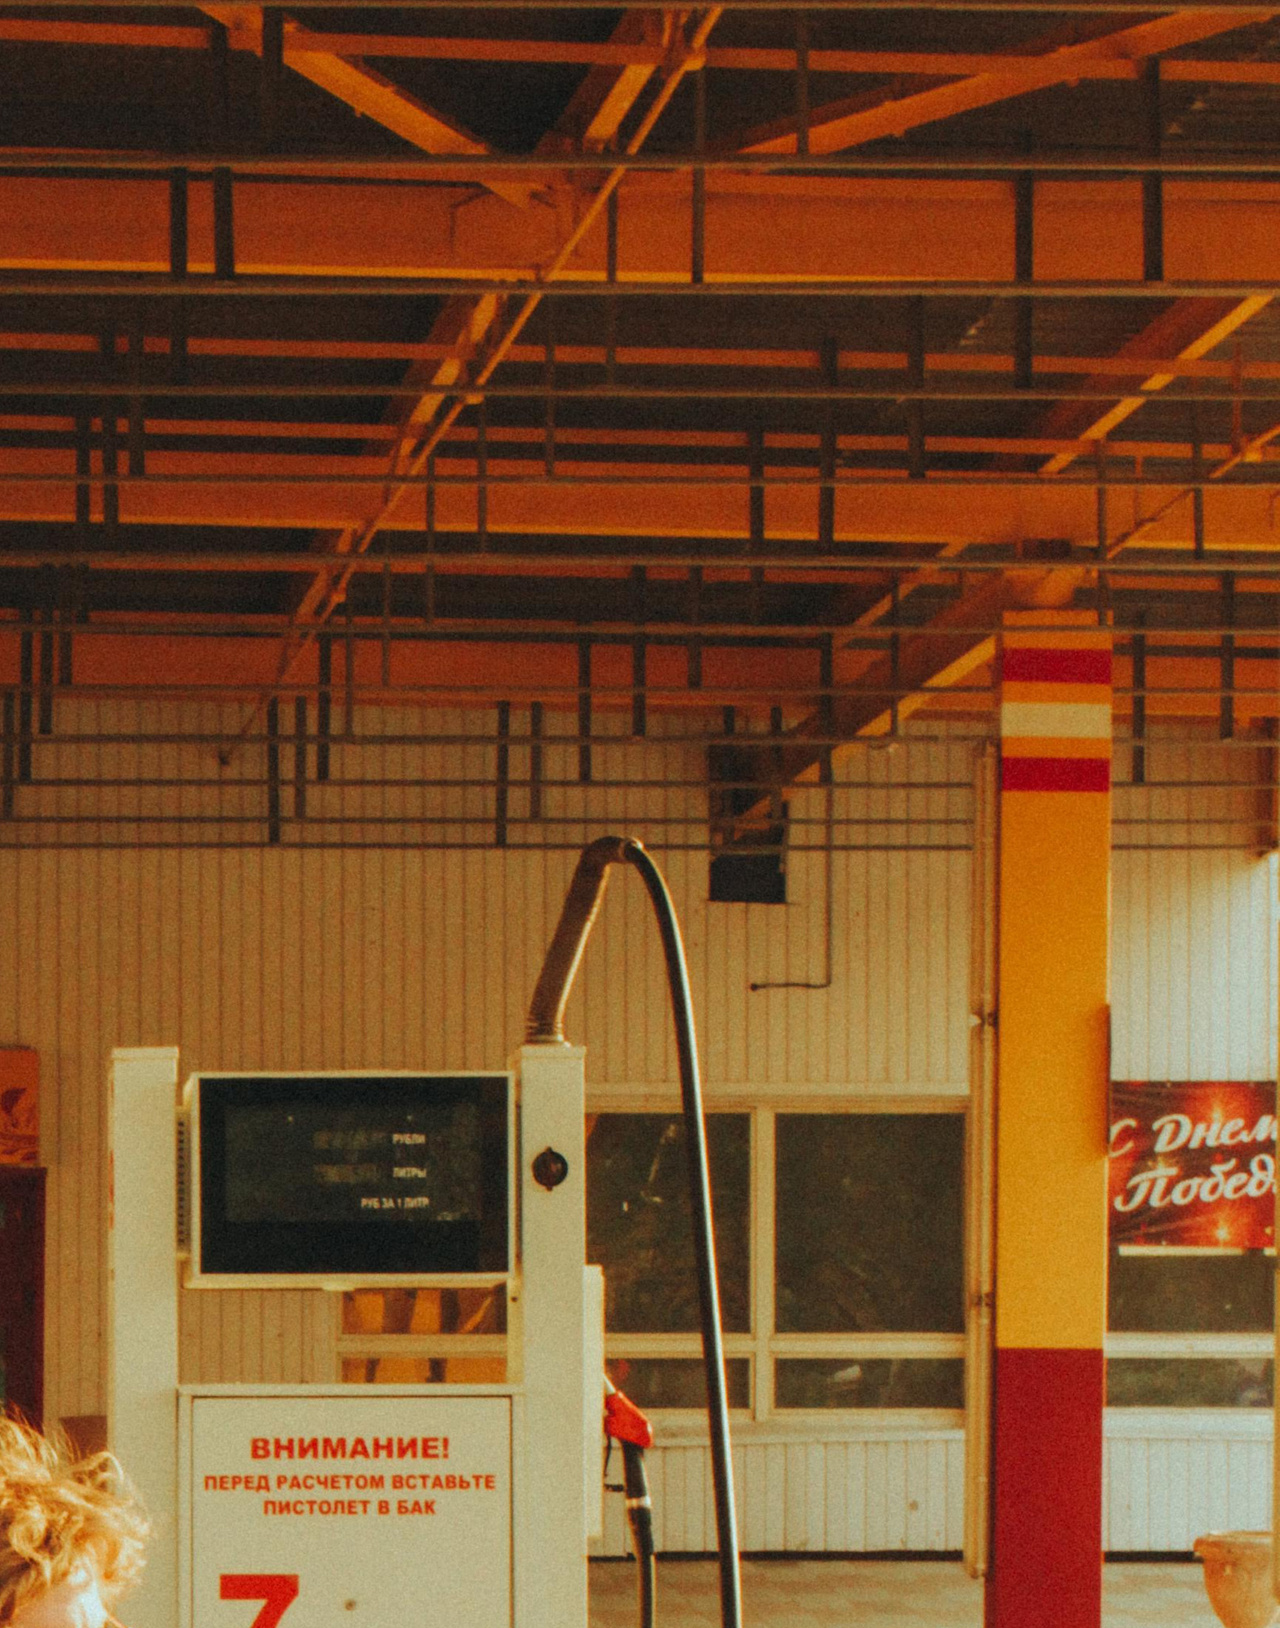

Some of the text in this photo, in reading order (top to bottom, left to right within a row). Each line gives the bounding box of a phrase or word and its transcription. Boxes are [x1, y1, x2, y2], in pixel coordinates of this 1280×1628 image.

[1114, 1154, 1276, 1213] Побед
[250, 1437, 449, 1459] ВНИМАНИЕ!
[204, 1474, 496, 1492] ПЕРЕД РАСЧЕТОМ ВСТАВЬТЕ
[263, 1500, 436, 1515] ПИСТОЛЕТ В БАК
